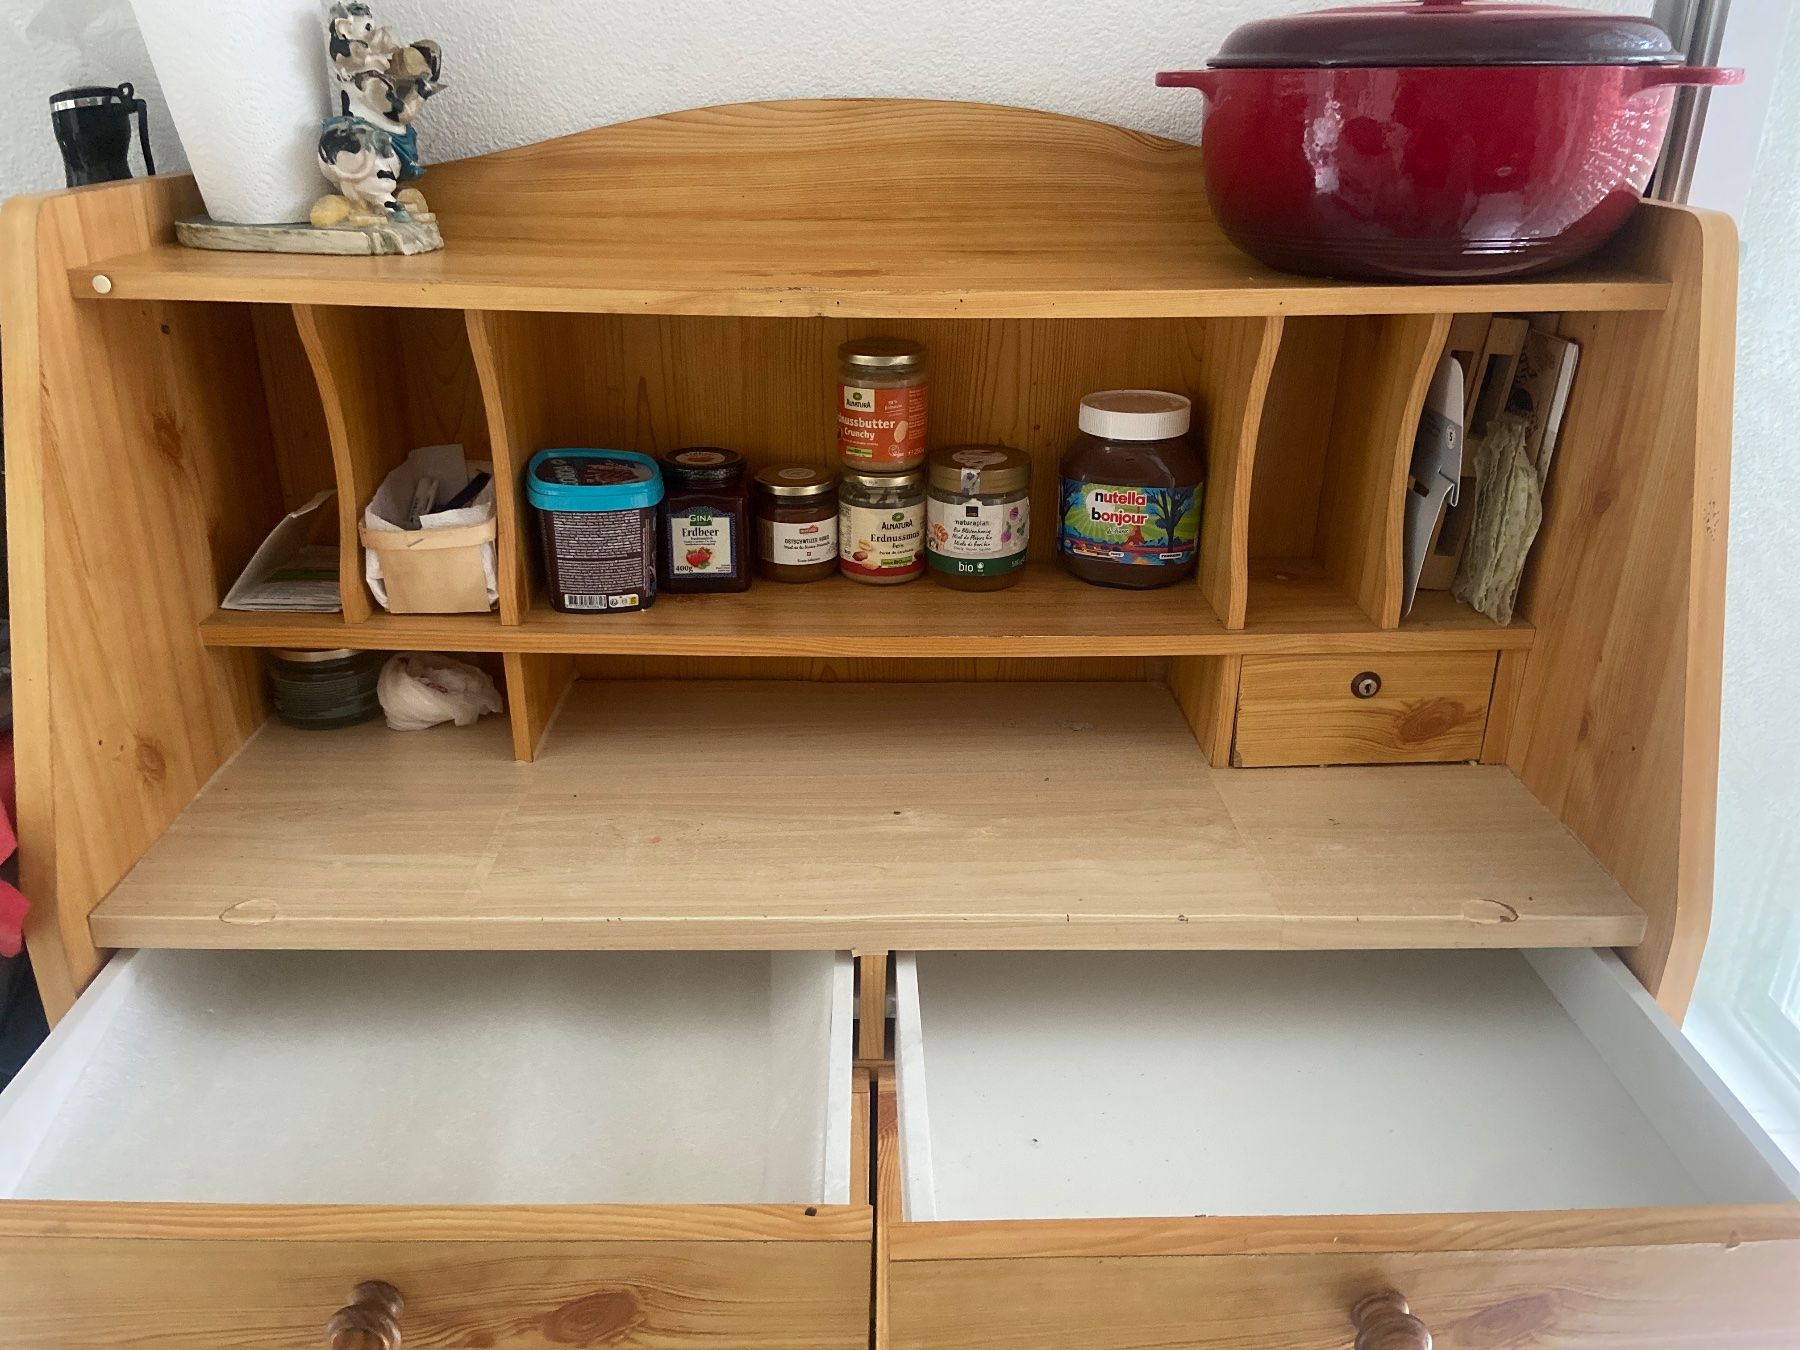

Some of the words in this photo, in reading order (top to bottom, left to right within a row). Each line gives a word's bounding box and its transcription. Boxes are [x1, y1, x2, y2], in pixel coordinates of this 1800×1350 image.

[846, 398, 872, 409] ALNATURA
[844, 427, 875, 441] Crunchy
[1094, 490, 1147, 506] nutella
[689, 514, 713, 522] GINA
[1091, 507, 1147, 526] bonjour
[881, 519, 913, 530] ALNATURA
[682, 527, 719, 537] Erdbeer
[870, 531, 920, 543] Erdnussmus
[675, 565, 694, 573] 400g
[958, 561, 974, 573] bio
